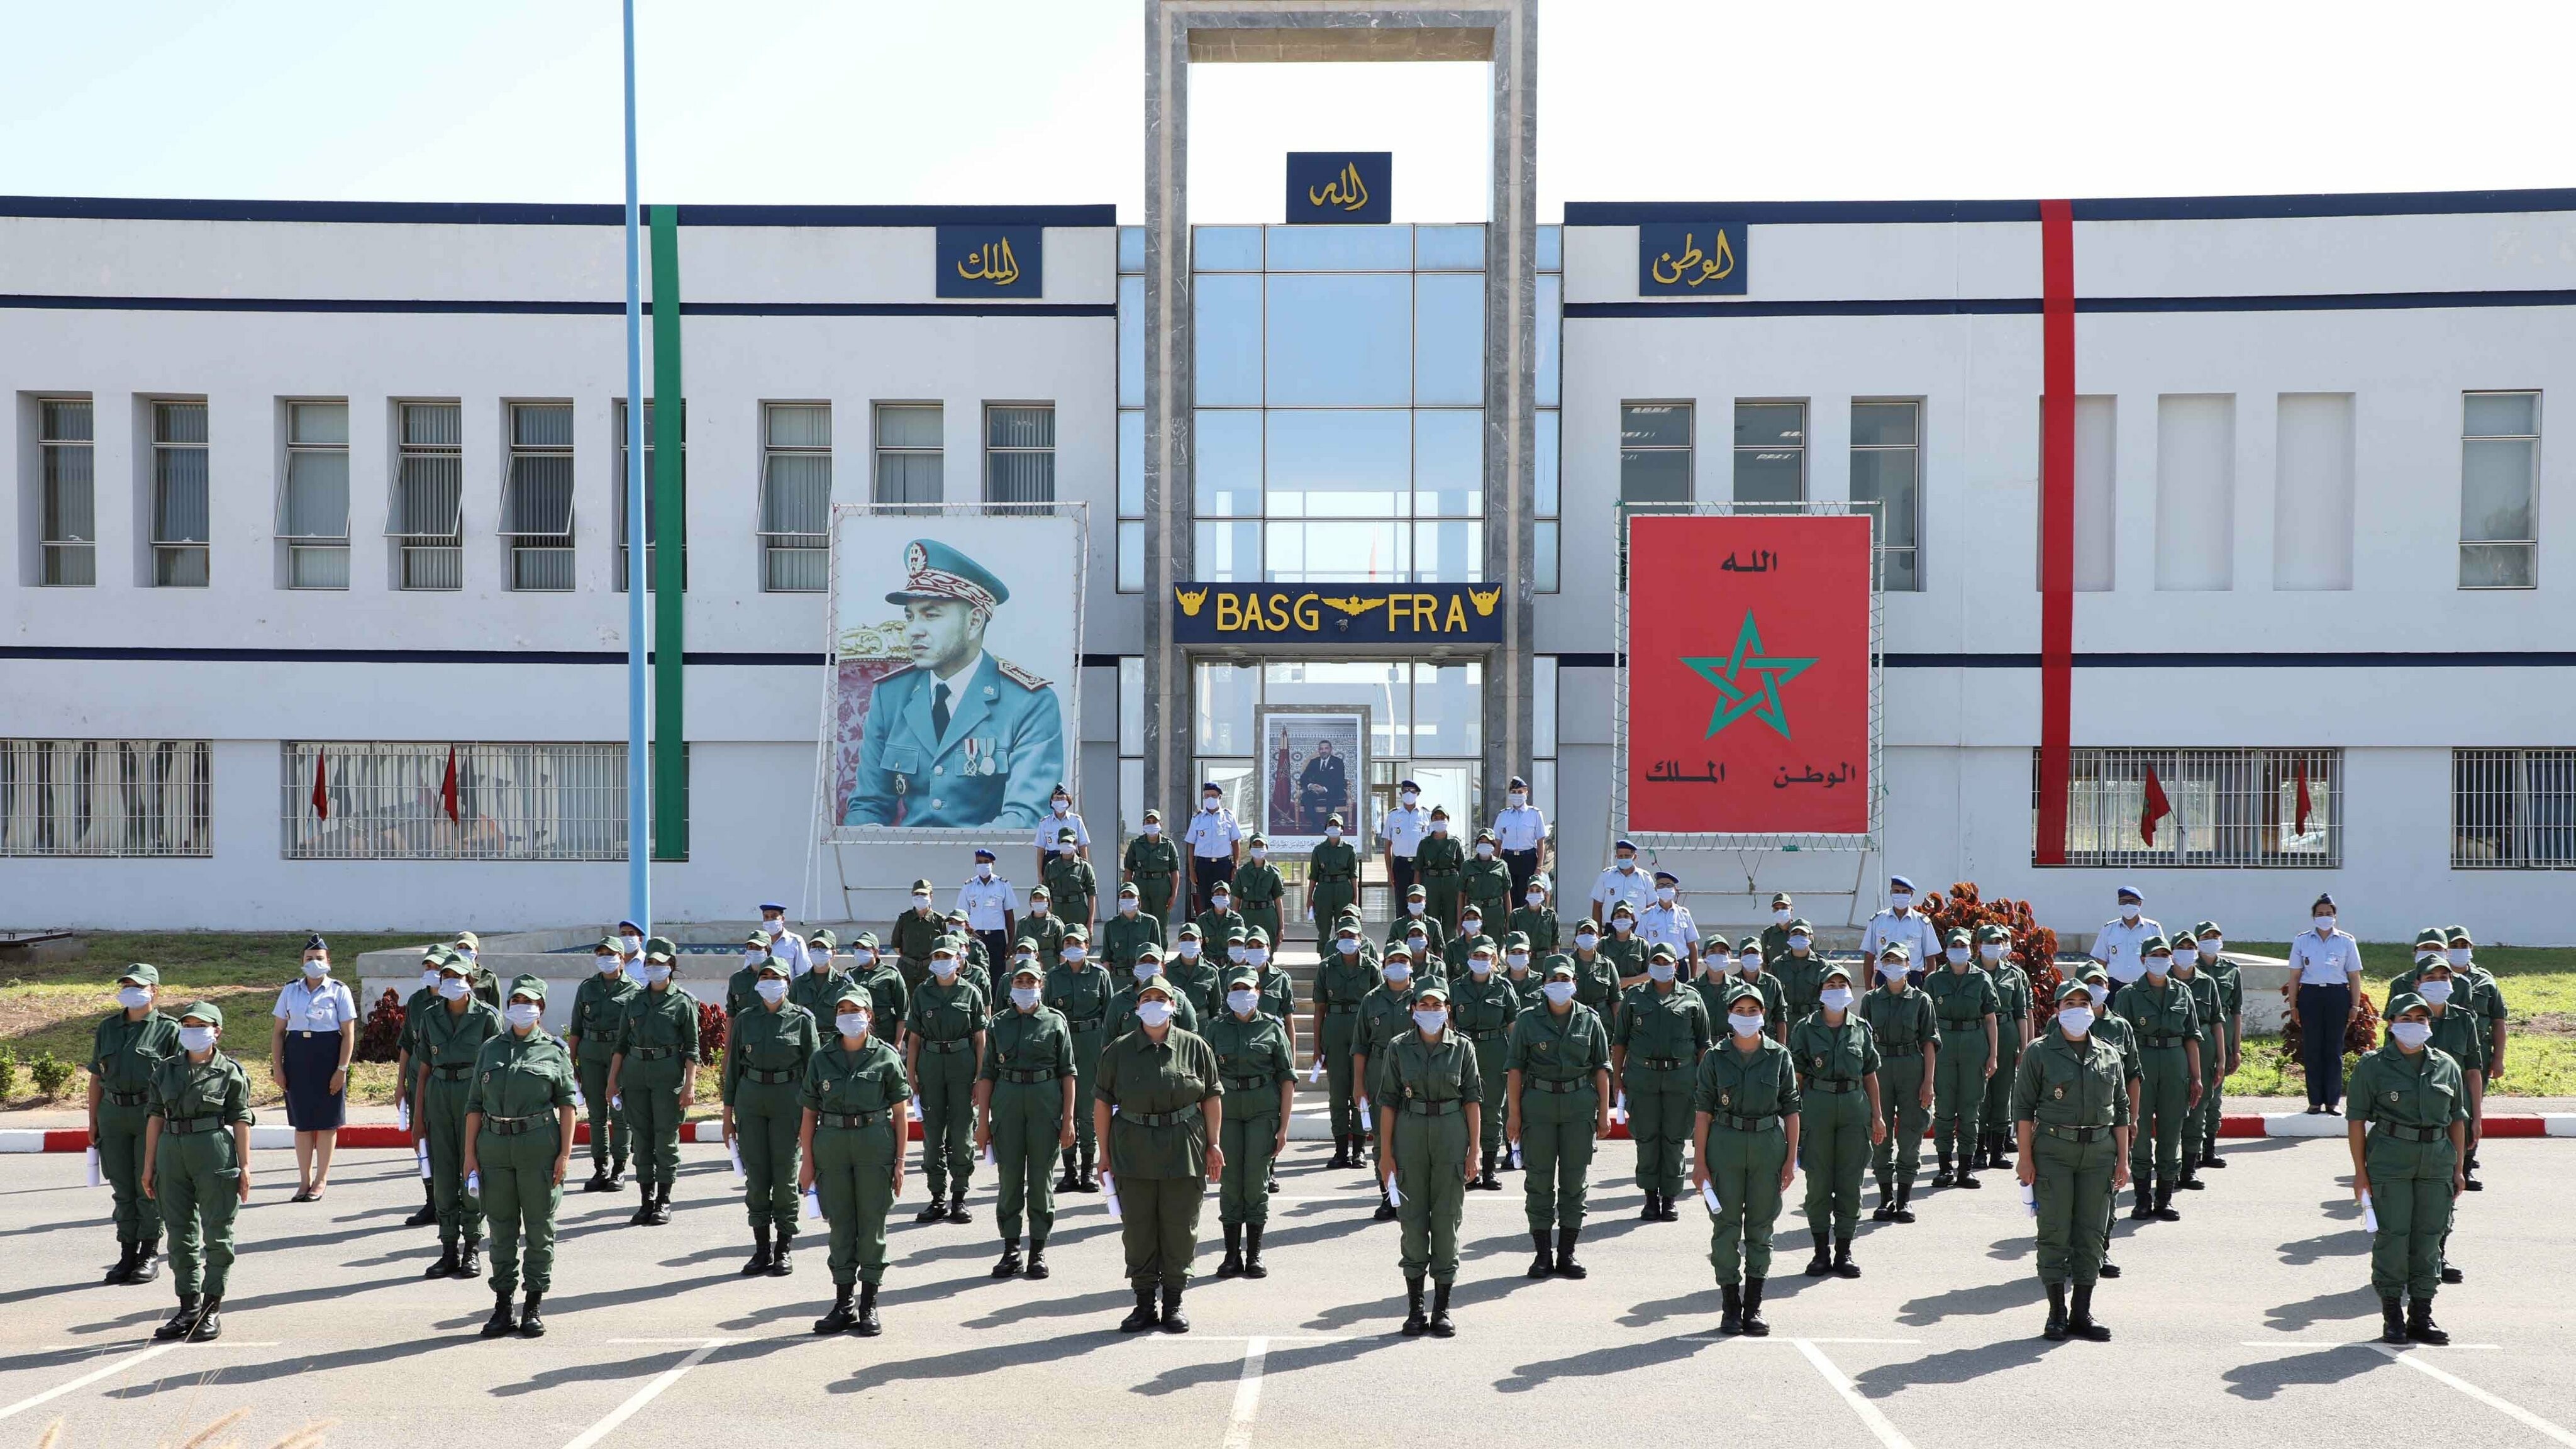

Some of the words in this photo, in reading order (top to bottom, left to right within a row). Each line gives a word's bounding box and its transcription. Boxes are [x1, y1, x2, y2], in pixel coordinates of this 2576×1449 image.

[1310, 162, 1368, 211] الله
[958, 237, 1019, 285] الملك
[1652, 229, 1734, 286] الوطن
[1720, 550, 1778, 572] الله
[1216, 593, 1319, 631] BASG
[1388, 594, 1468, 633] FRA
[1645, 760, 1726, 784] الملك
[1773, 762, 1856, 789] الوطن
